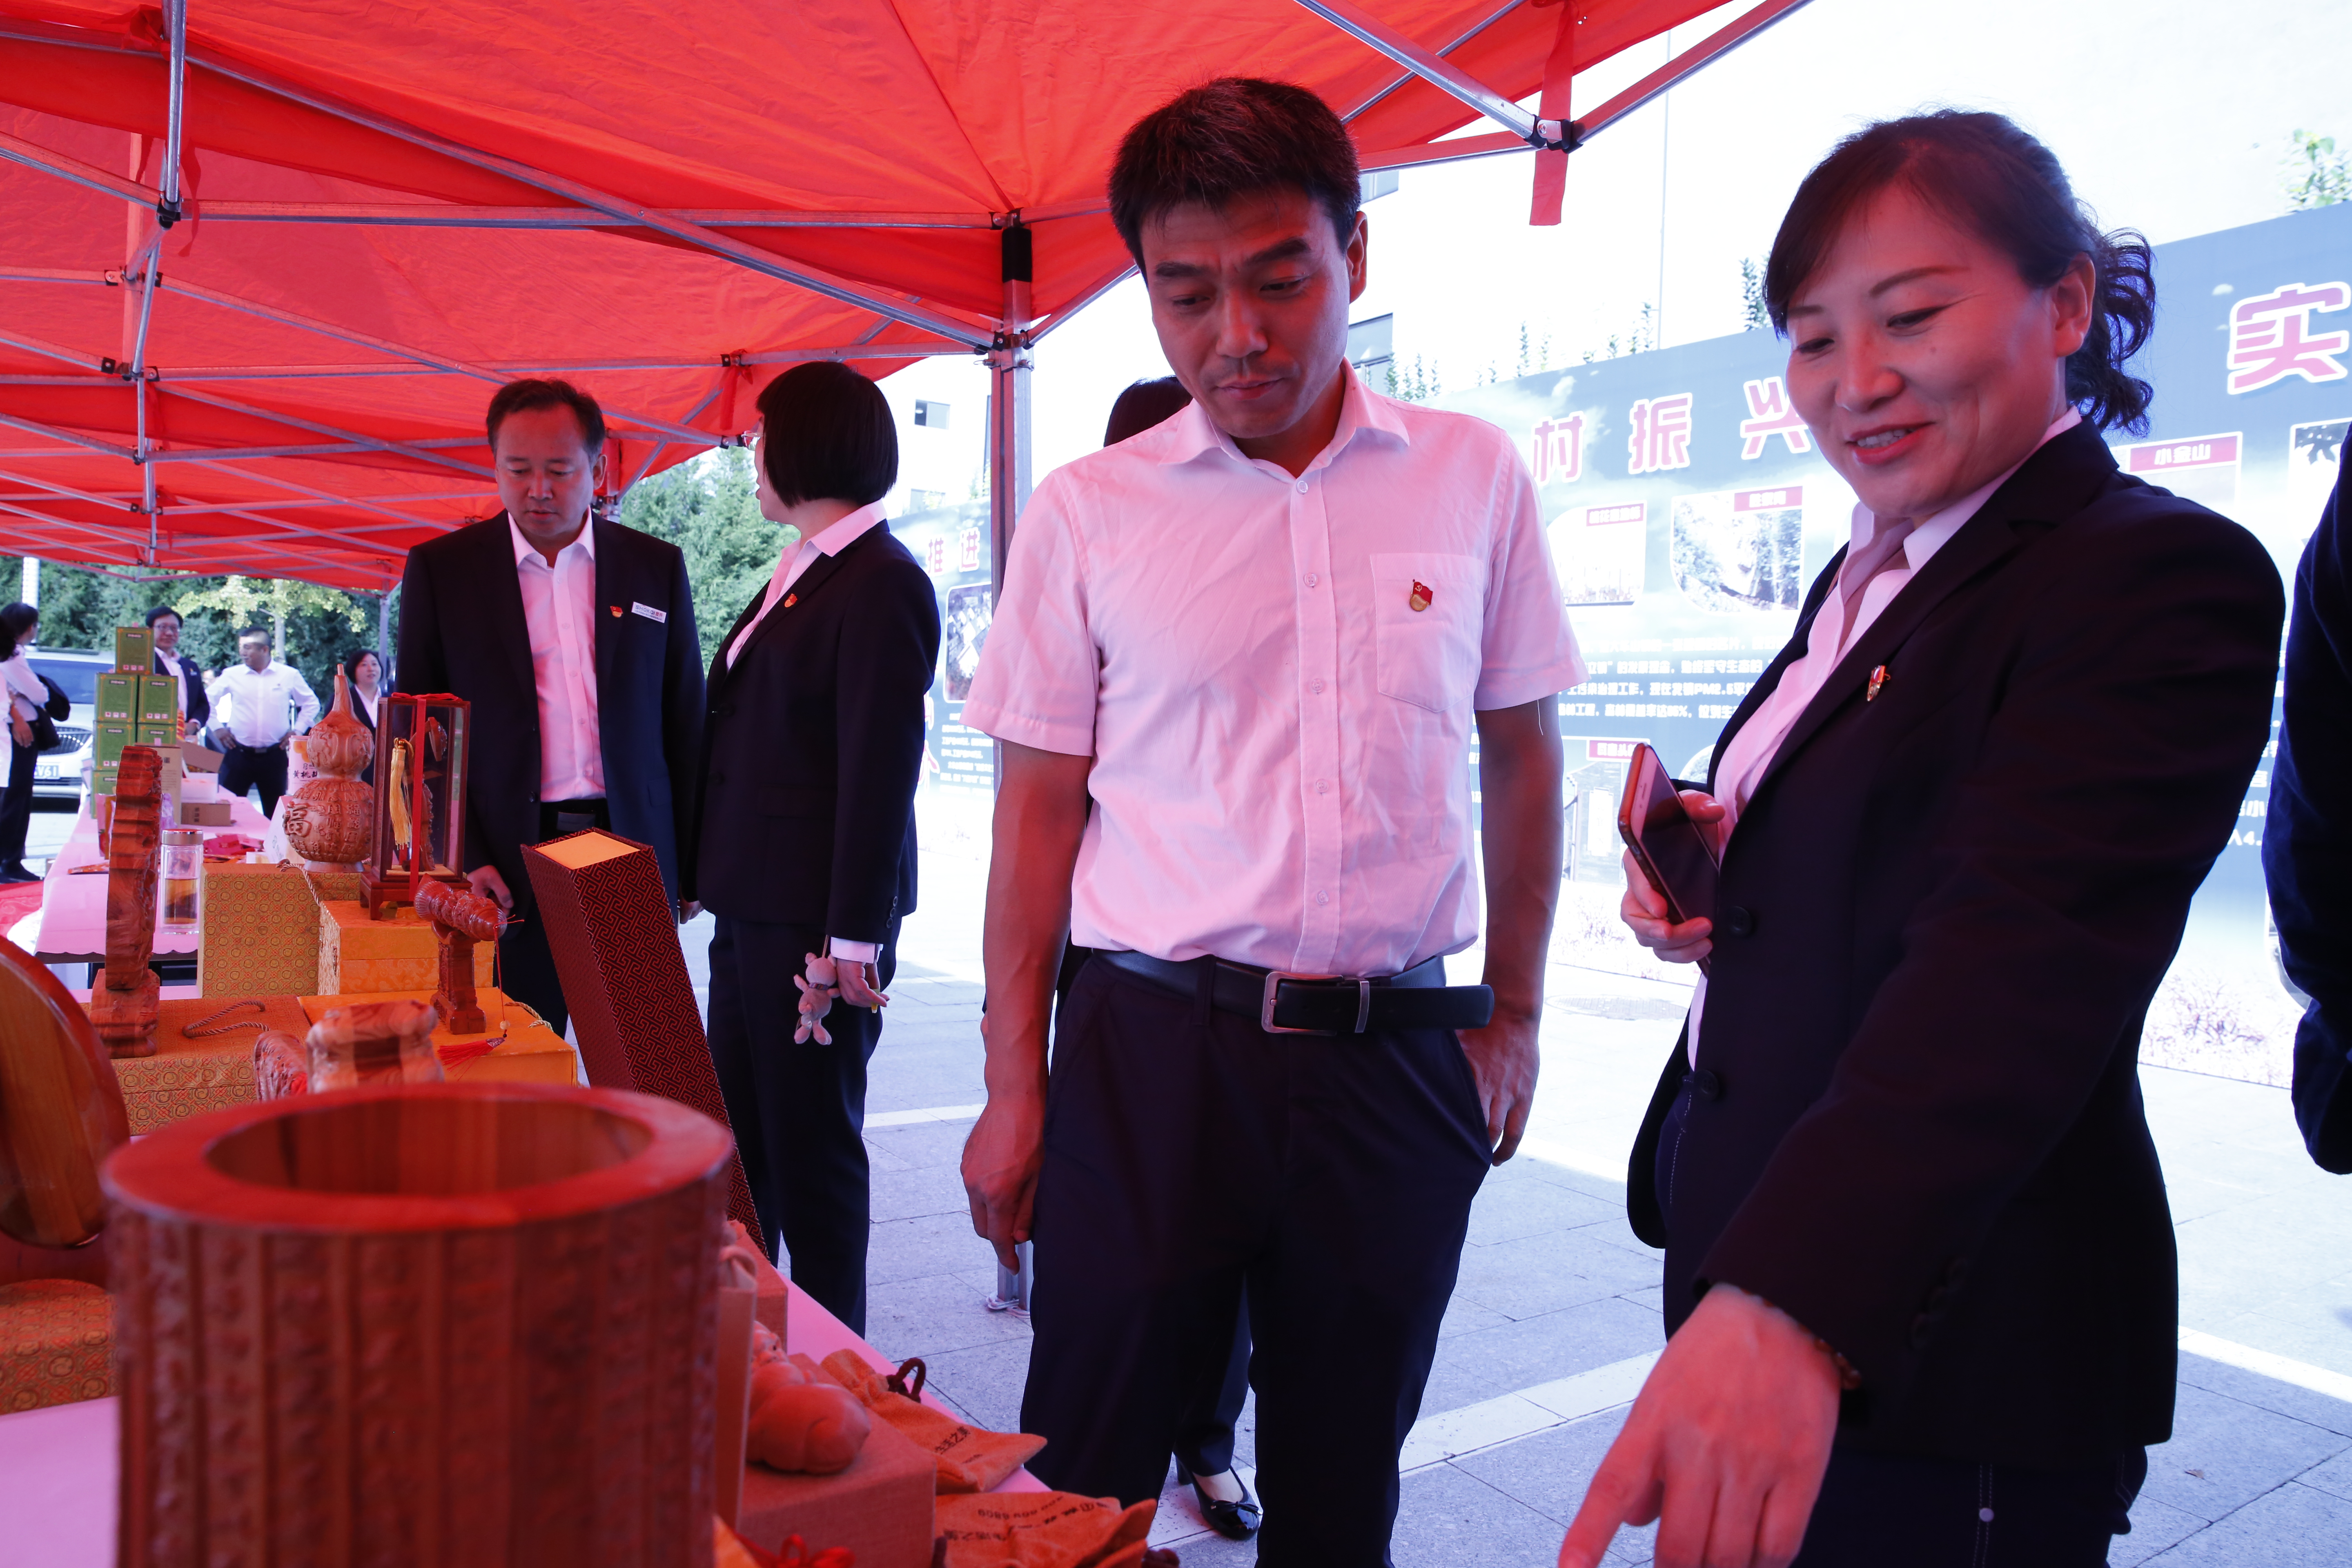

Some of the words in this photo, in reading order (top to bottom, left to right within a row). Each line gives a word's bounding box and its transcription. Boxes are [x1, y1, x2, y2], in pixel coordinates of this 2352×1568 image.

[2227, 282, 2351, 394] 实
[2154, 443, 2211, 465] 小金山
[926, 527, 980, 576] 推进
